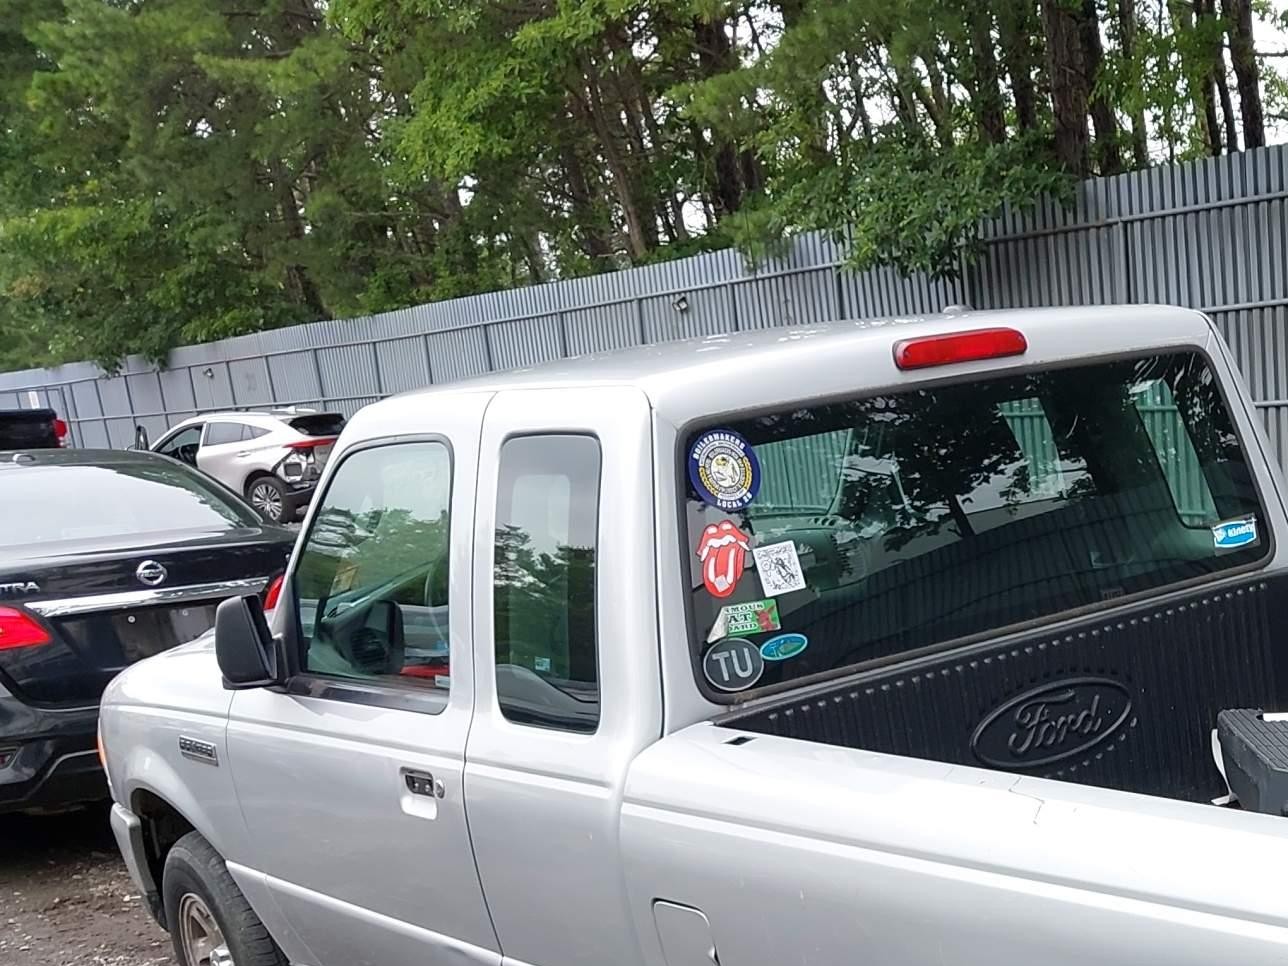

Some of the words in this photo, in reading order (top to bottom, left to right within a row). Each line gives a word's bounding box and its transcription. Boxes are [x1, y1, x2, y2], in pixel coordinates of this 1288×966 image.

[692, 432, 746, 460] BOILERMAKERS
[0, 582, 41, 593] TRA
[728, 613, 752, 624] AT
[711, 647, 753, 682] TU
[1007, 688, 1102, 754] Ford
